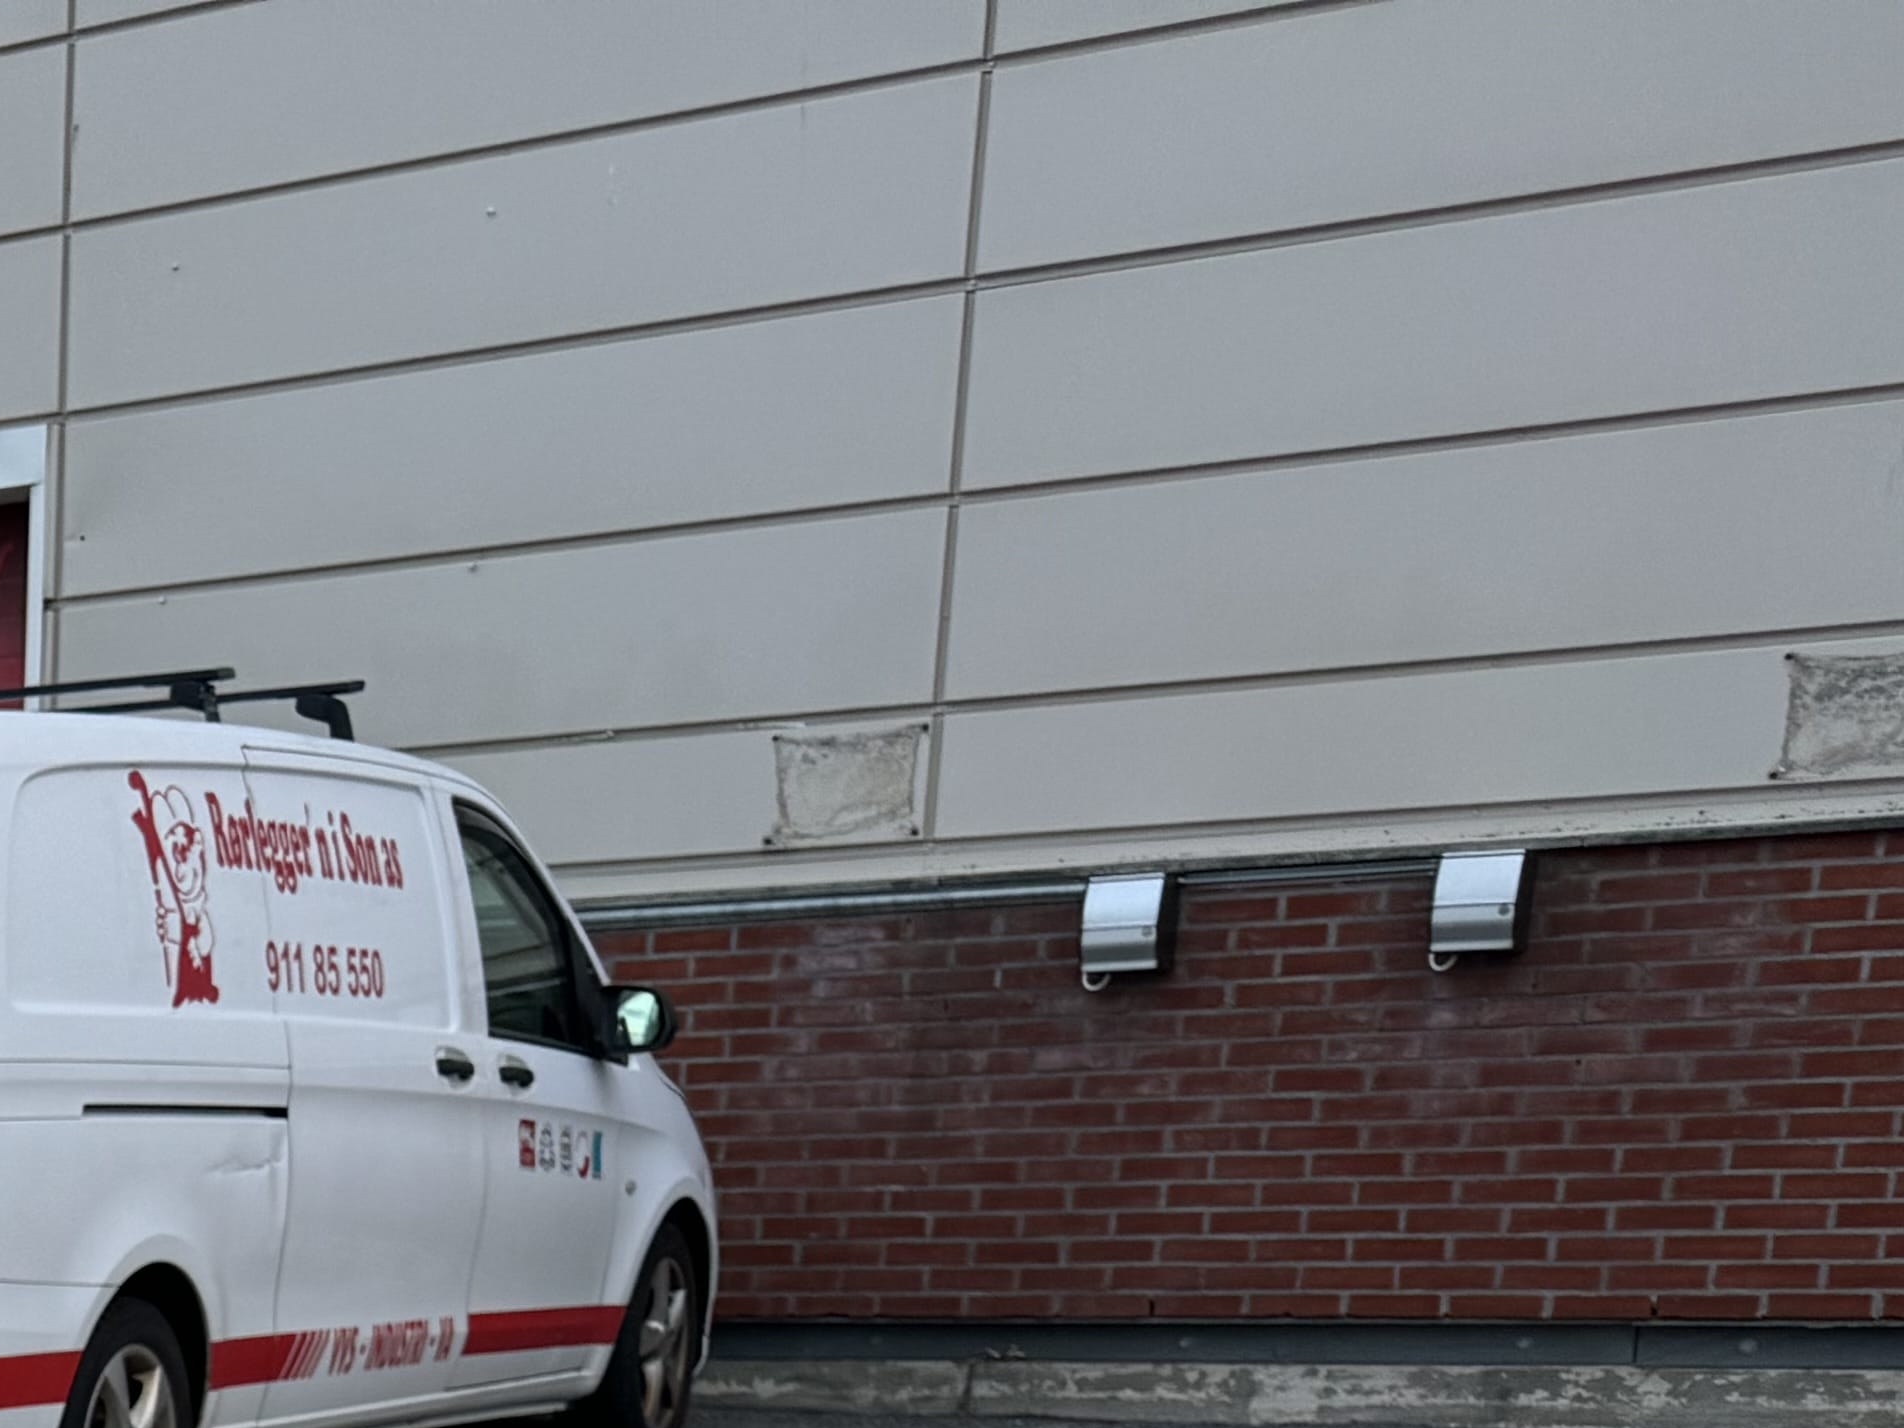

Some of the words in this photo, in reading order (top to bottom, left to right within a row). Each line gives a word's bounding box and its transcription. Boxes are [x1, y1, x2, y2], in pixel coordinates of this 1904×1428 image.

[340, 811, 383, 887] Son
[381, 837, 404, 889] as
[265, 940, 306, 993] 911
[313, 945, 341, 996] 85
[347, 949, 385, 998] 550
